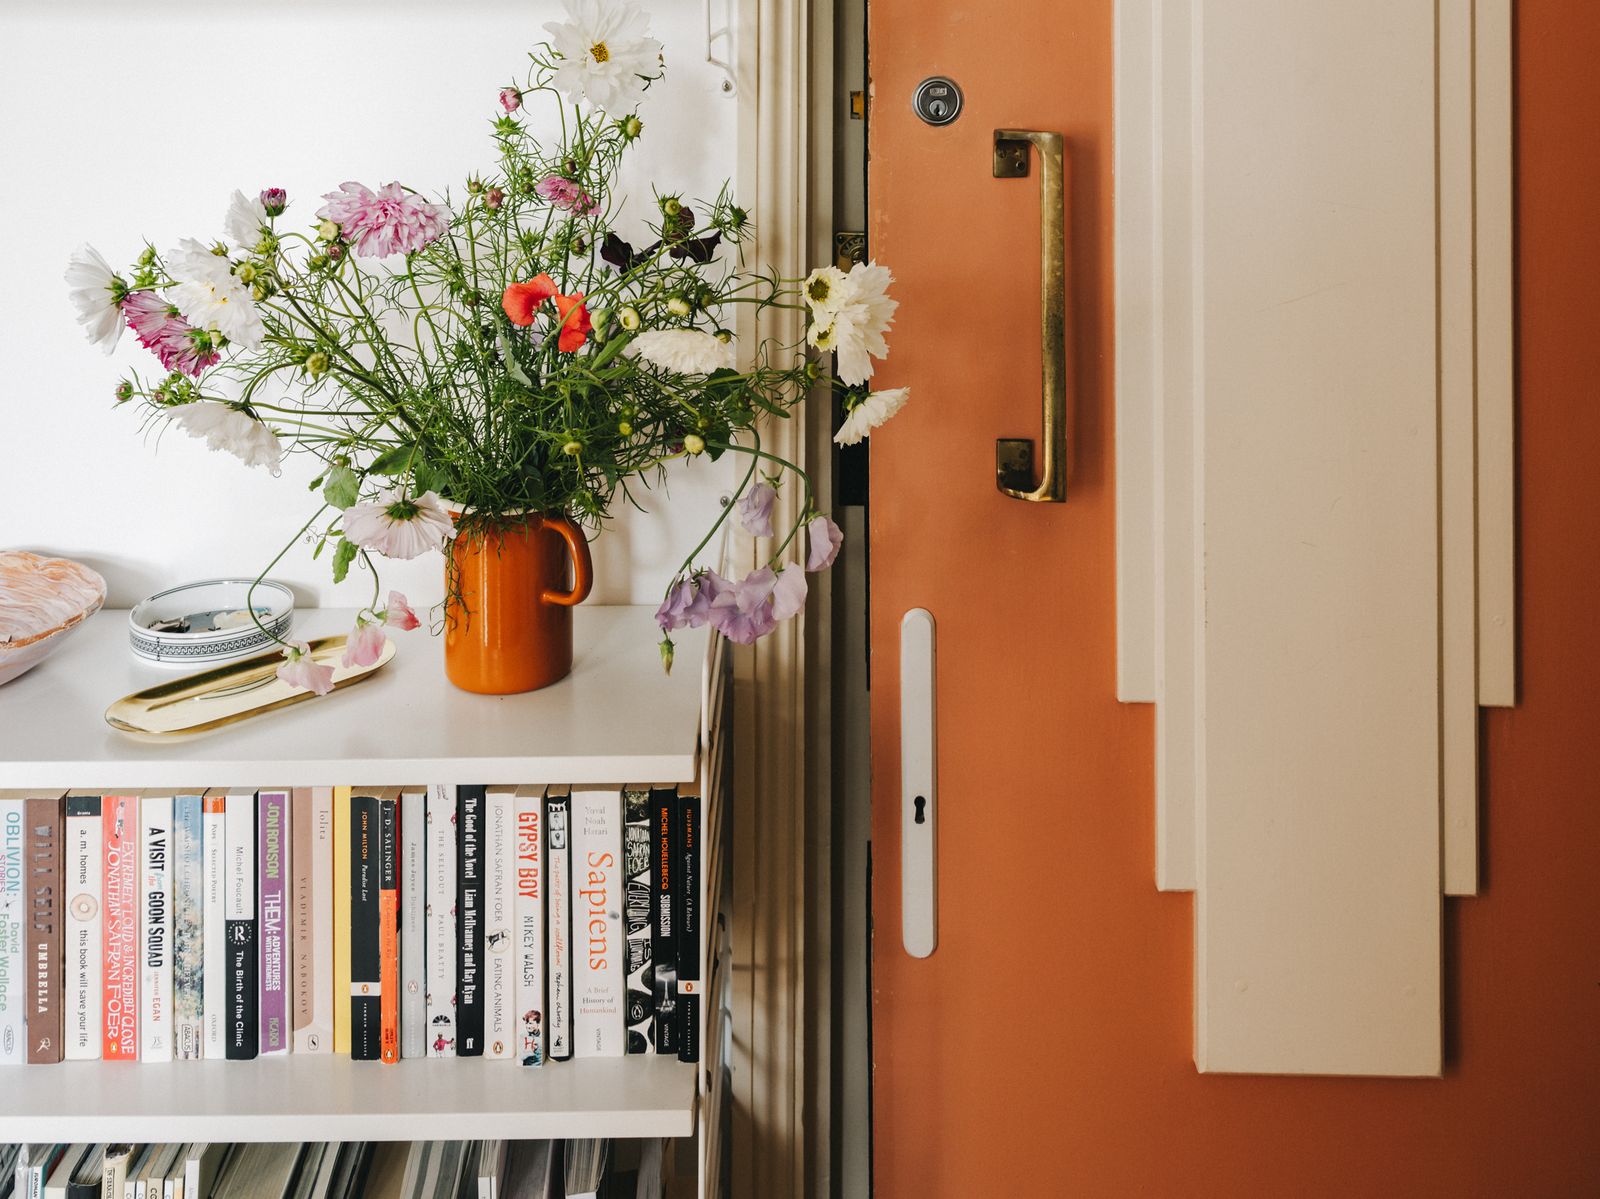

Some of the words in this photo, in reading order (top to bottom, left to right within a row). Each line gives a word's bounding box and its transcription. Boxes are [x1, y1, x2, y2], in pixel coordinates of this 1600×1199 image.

[384, 807, 392, 815] J.
[465, 798, 476, 812] The
[149, 828, 165, 836] A
[319, 811, 328, 840] lolita
[385, 818, 392, 829] D.
[465, 814, 477, 832] Good
[465, 834, 476, 842] of
[494, 805, 503, 856] JONATHAN
[518, 812, 538, 862] GYPSY
[661, 808, 669, 836] MICHEL
[6, 812, 20, 896] OBLIVION:
[80, 841, 87, 852] m.
[149, 839, 165, 871] VISIT
[235, 847, 243, 875] Michel
[266, 829, 279, 878] RONSON
[384, 833, 392, 881] SALINGER
[465, 844, 476, 856] the
[80, 855, 88, 884] homes
[107, 841, 121, 916] JONATHAN
[122, 841, 133, 908] EXTREMELY
[361, 865, 369, 888] Paradise
[465, 859, 476, 878] Novel
[495, 858, 503, 895] SAFRAN
[661, 838, 669, 890] HOUELLEBECQ
[235, 878, 244, 914] Foucault
[361, 889, 369, 901] Lost
[465, 889, 476, 908] Liam
[519, 867, 538, 899] BOY
[34, 886, 52, 934] SELF
[149, 892, 164, 925] GOON
[264, 890, 281, 934] THEM:
[495, 898, 503, 922] FOER
[579, 851, 614, 971] Sapiens
[660, 895, 671, 937] SUBMISSION
[0, 913, 9, 954] Foster
[10, 922, 19, 953] David
[80, 930, 88, 946] this
[121, 910, 133, 942] LOUD
[523, 915, 534, 948] MIKEY
[80, 949, 88, 970] book
[108, 920, 121, 983] SAFRAN
[123, 944, 133, 953] &
[148, 928, 164, 967] SQUAD
[464, 953, 476, 967] and
[0, 957, 9, 1012] Wallace
[38, 943, 48, 1013] UMBRELLA
[80, 972, 88, 988] will
[122, 955, 134, 1015] INCREDIBLY
[300, 954, 308, 1016] NABOKOV
[462, 968, 476, 983] Ray
[494, 958, 502, 991] EATING
[524, 954, 534, 987] WALSH
[152, 997, 161, 1022] EGAN
[236, 994, 244, 1002] of
[462, 985, 476, 1004] Ryan
[78, 1010, 87, 1031] your
[107, 984, 121, 1040] FOER
[494, 992, 502, 1032] ANIMALS
[80, 1033, 88, 1047] life
[121, 1016, 134, 1054] CLOSE
[236, 1021, 244, 1047] Clinic
